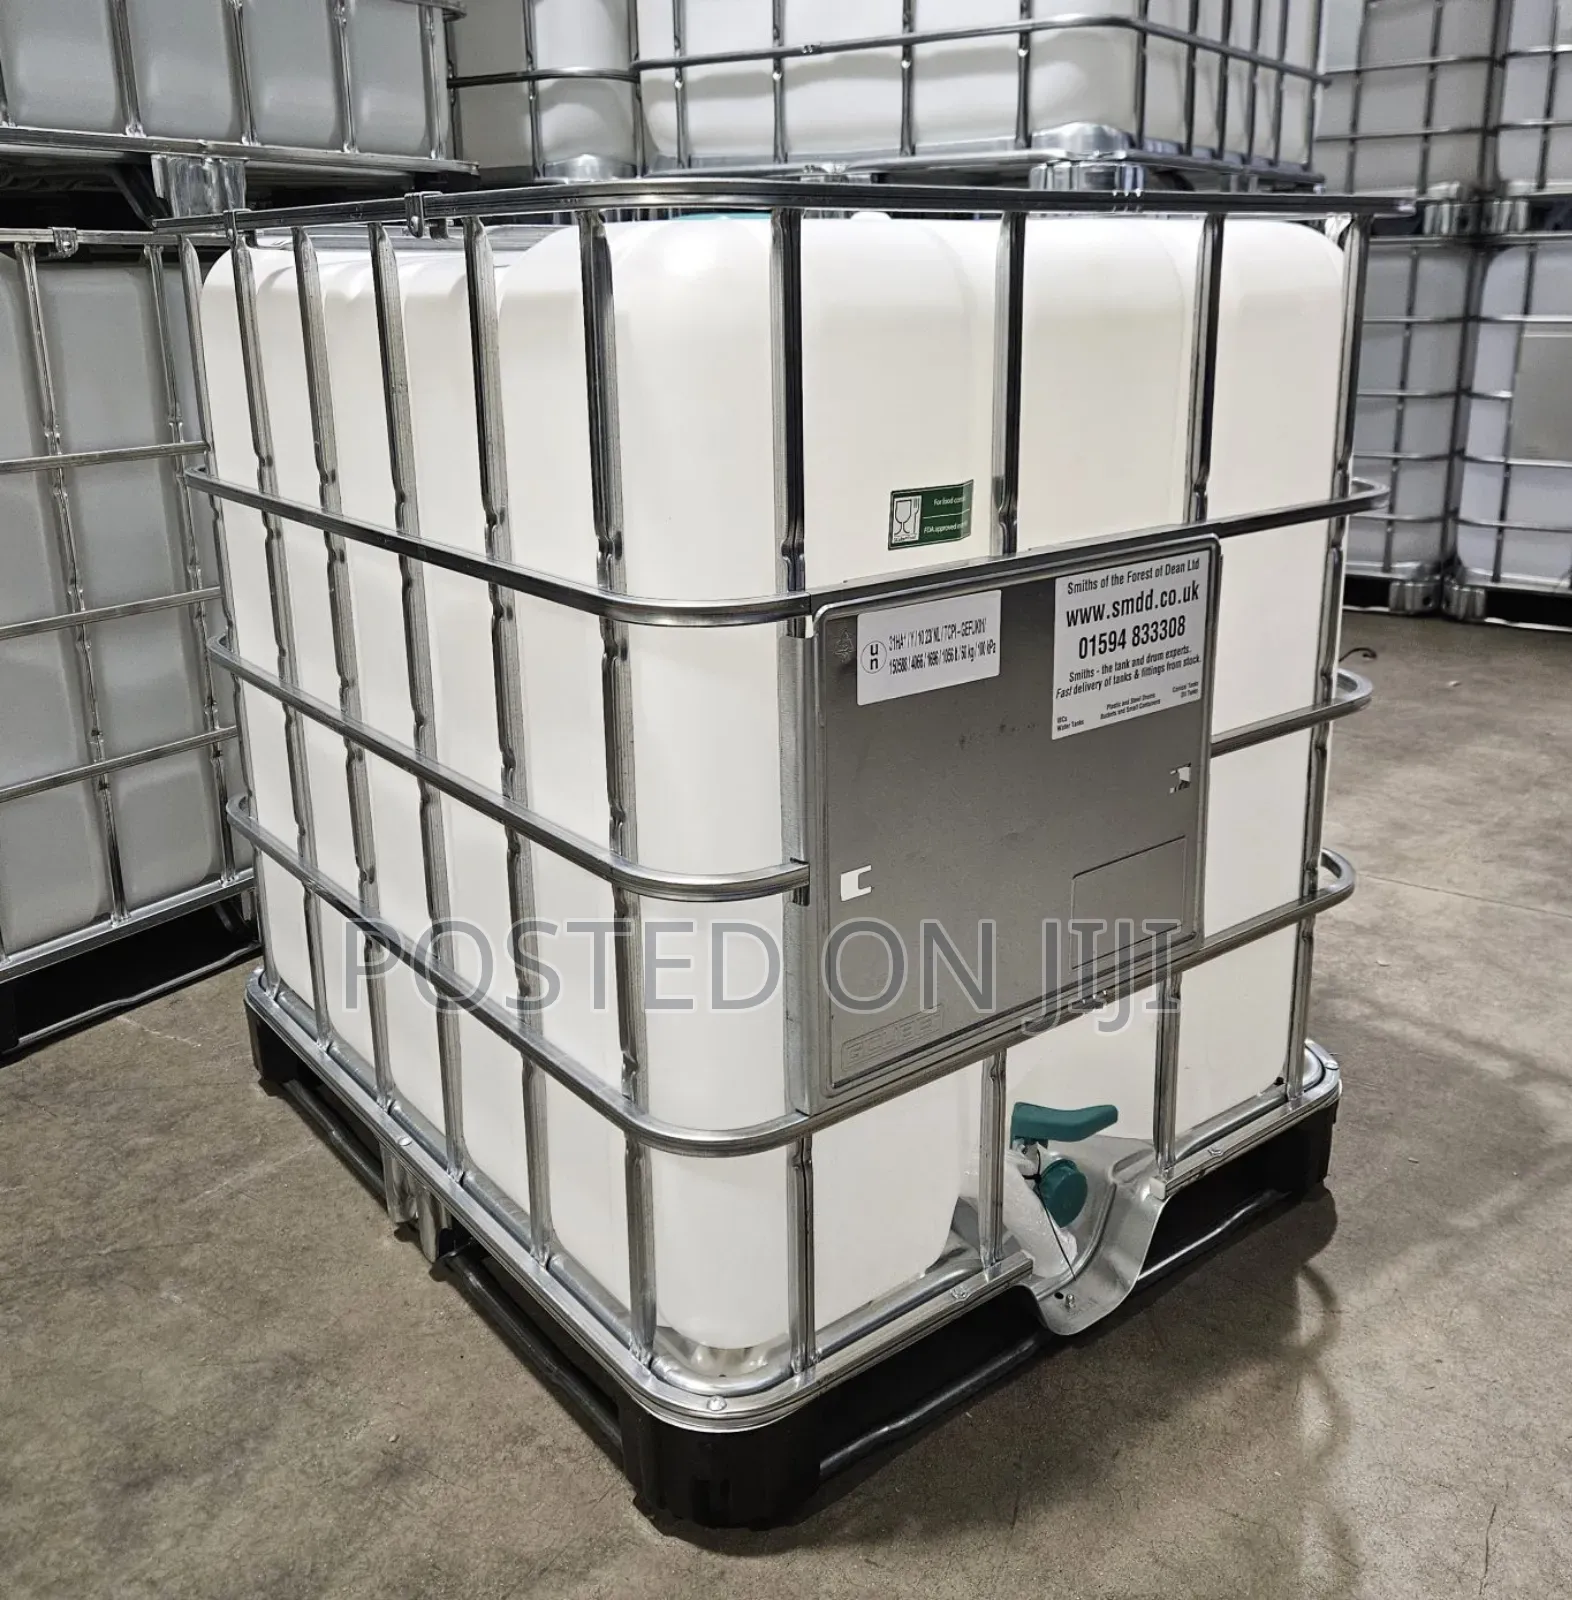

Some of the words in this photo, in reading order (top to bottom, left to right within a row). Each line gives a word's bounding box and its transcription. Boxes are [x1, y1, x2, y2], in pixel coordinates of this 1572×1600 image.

[1067, 579, 1098, 595] Smiths
[1100, 575, 1109, 588] of
[1111, 573, 1124, 587] the
[1127, 567, 1153, 583] Forest
[1155, 565, 1163, 578] of
[1165, 562, 1185, 576] Dean
[1187, 558, 1200, 571] Ltd
[1066, 580, 1200, 628] www.smdd.co.uk
[1079, 628, 1127, 660] 01594
[1132, 615, 1186, 647] 833308
[1056, 686, 1072, 699] Fast
[1073, 679, 1102, 695] delivery
[1104, 675, 1112, 688] of
[1113, 671, 1132, 685] tanks
[1134, 669, 1139, 680] &
[1141, 663, 1165, 677] fittings
[1167, 659, 1181, 672] from
[1069, 667, 1094, 683] Smiths
[1101, 661, 1112, 675] the
[1115, 658, 1130, 673] tank
[1132, 655, 1144, 668] and
[1146, 651, 1164, 665] drum
[1165, 645, 1191, 660] experts.
[1121, 699, 1129, 707] and
[1126, 704, 1139, 713] Small
